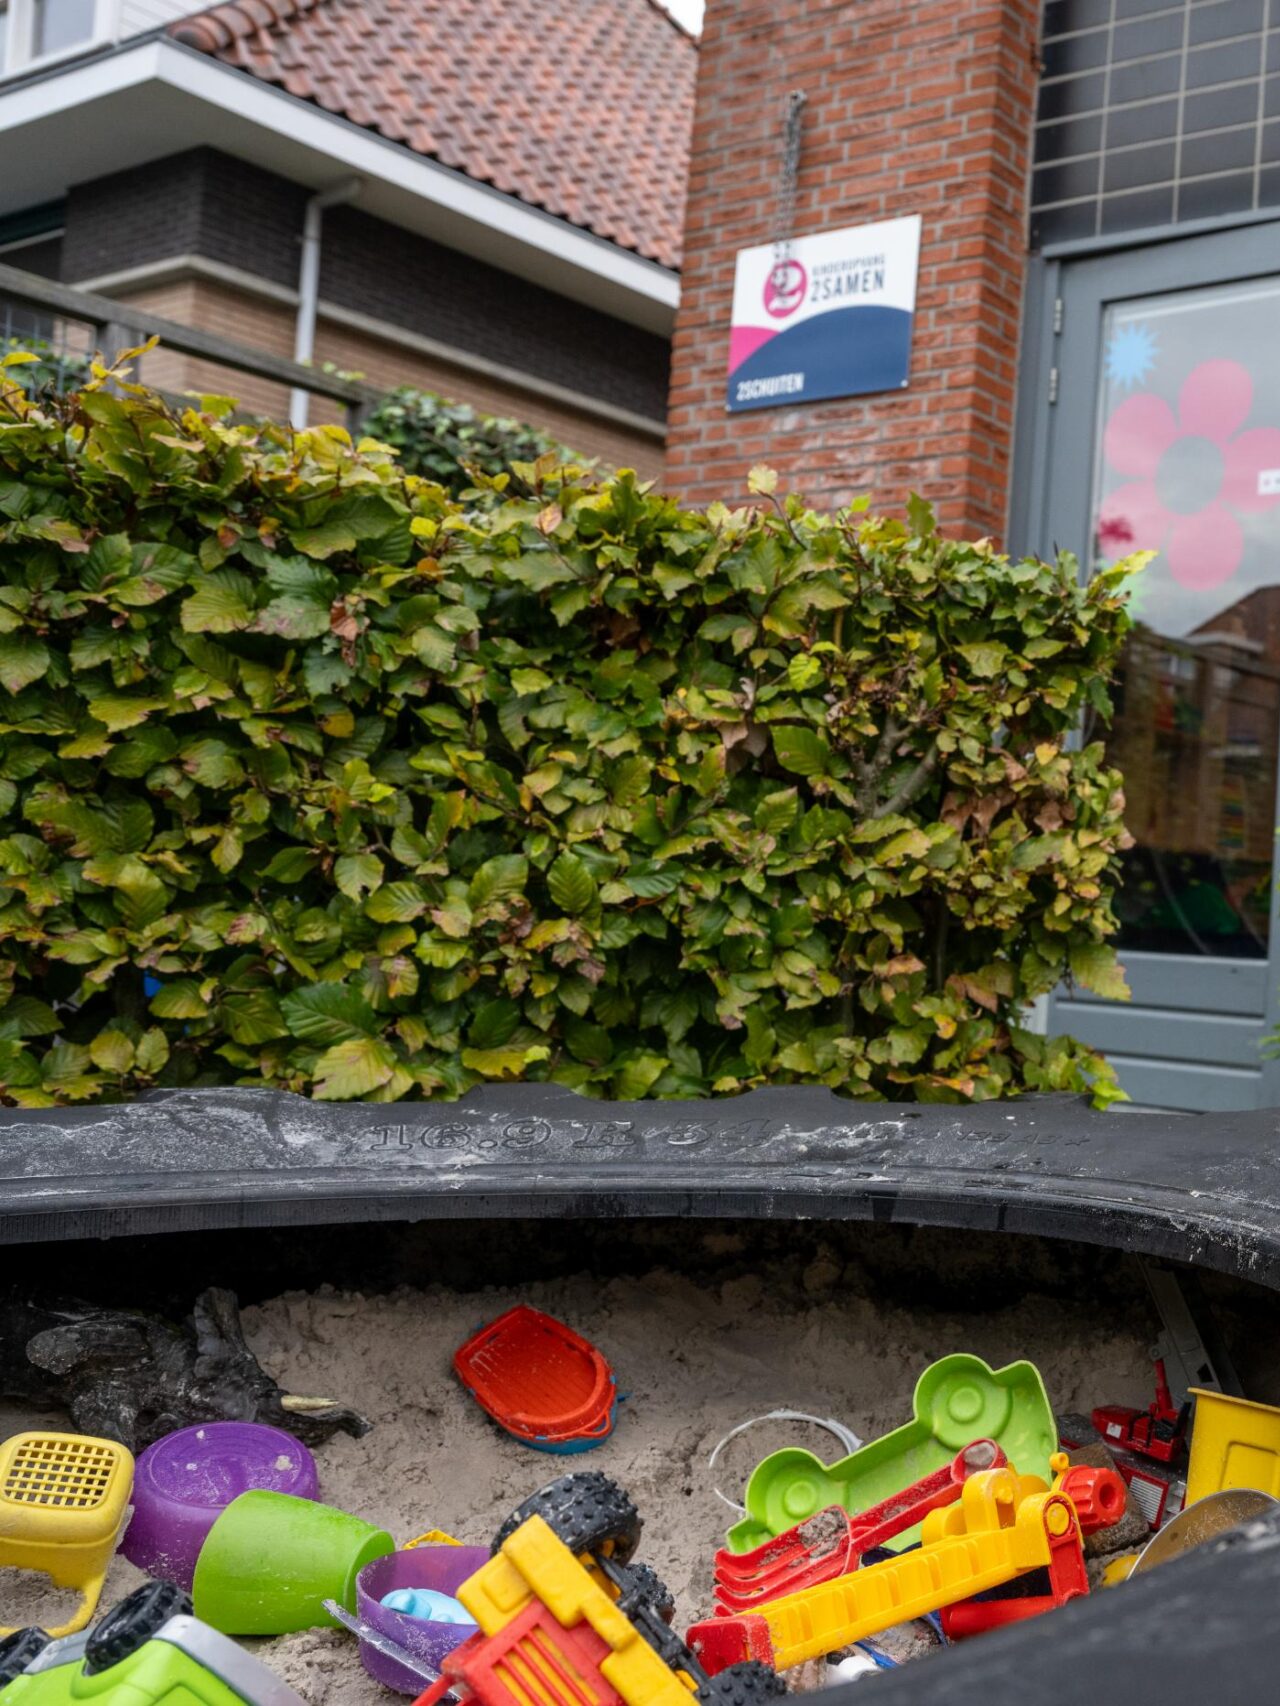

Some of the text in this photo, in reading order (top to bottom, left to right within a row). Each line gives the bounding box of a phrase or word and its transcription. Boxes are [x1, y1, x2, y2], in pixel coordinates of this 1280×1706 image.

[811, 268, 885, 302] 2SAMEN
[737, 372, 804, 401] 2SCHUITEN
[370, 1117, 552, 1151] 16.9
[571, 1119, 637, 1149] R
